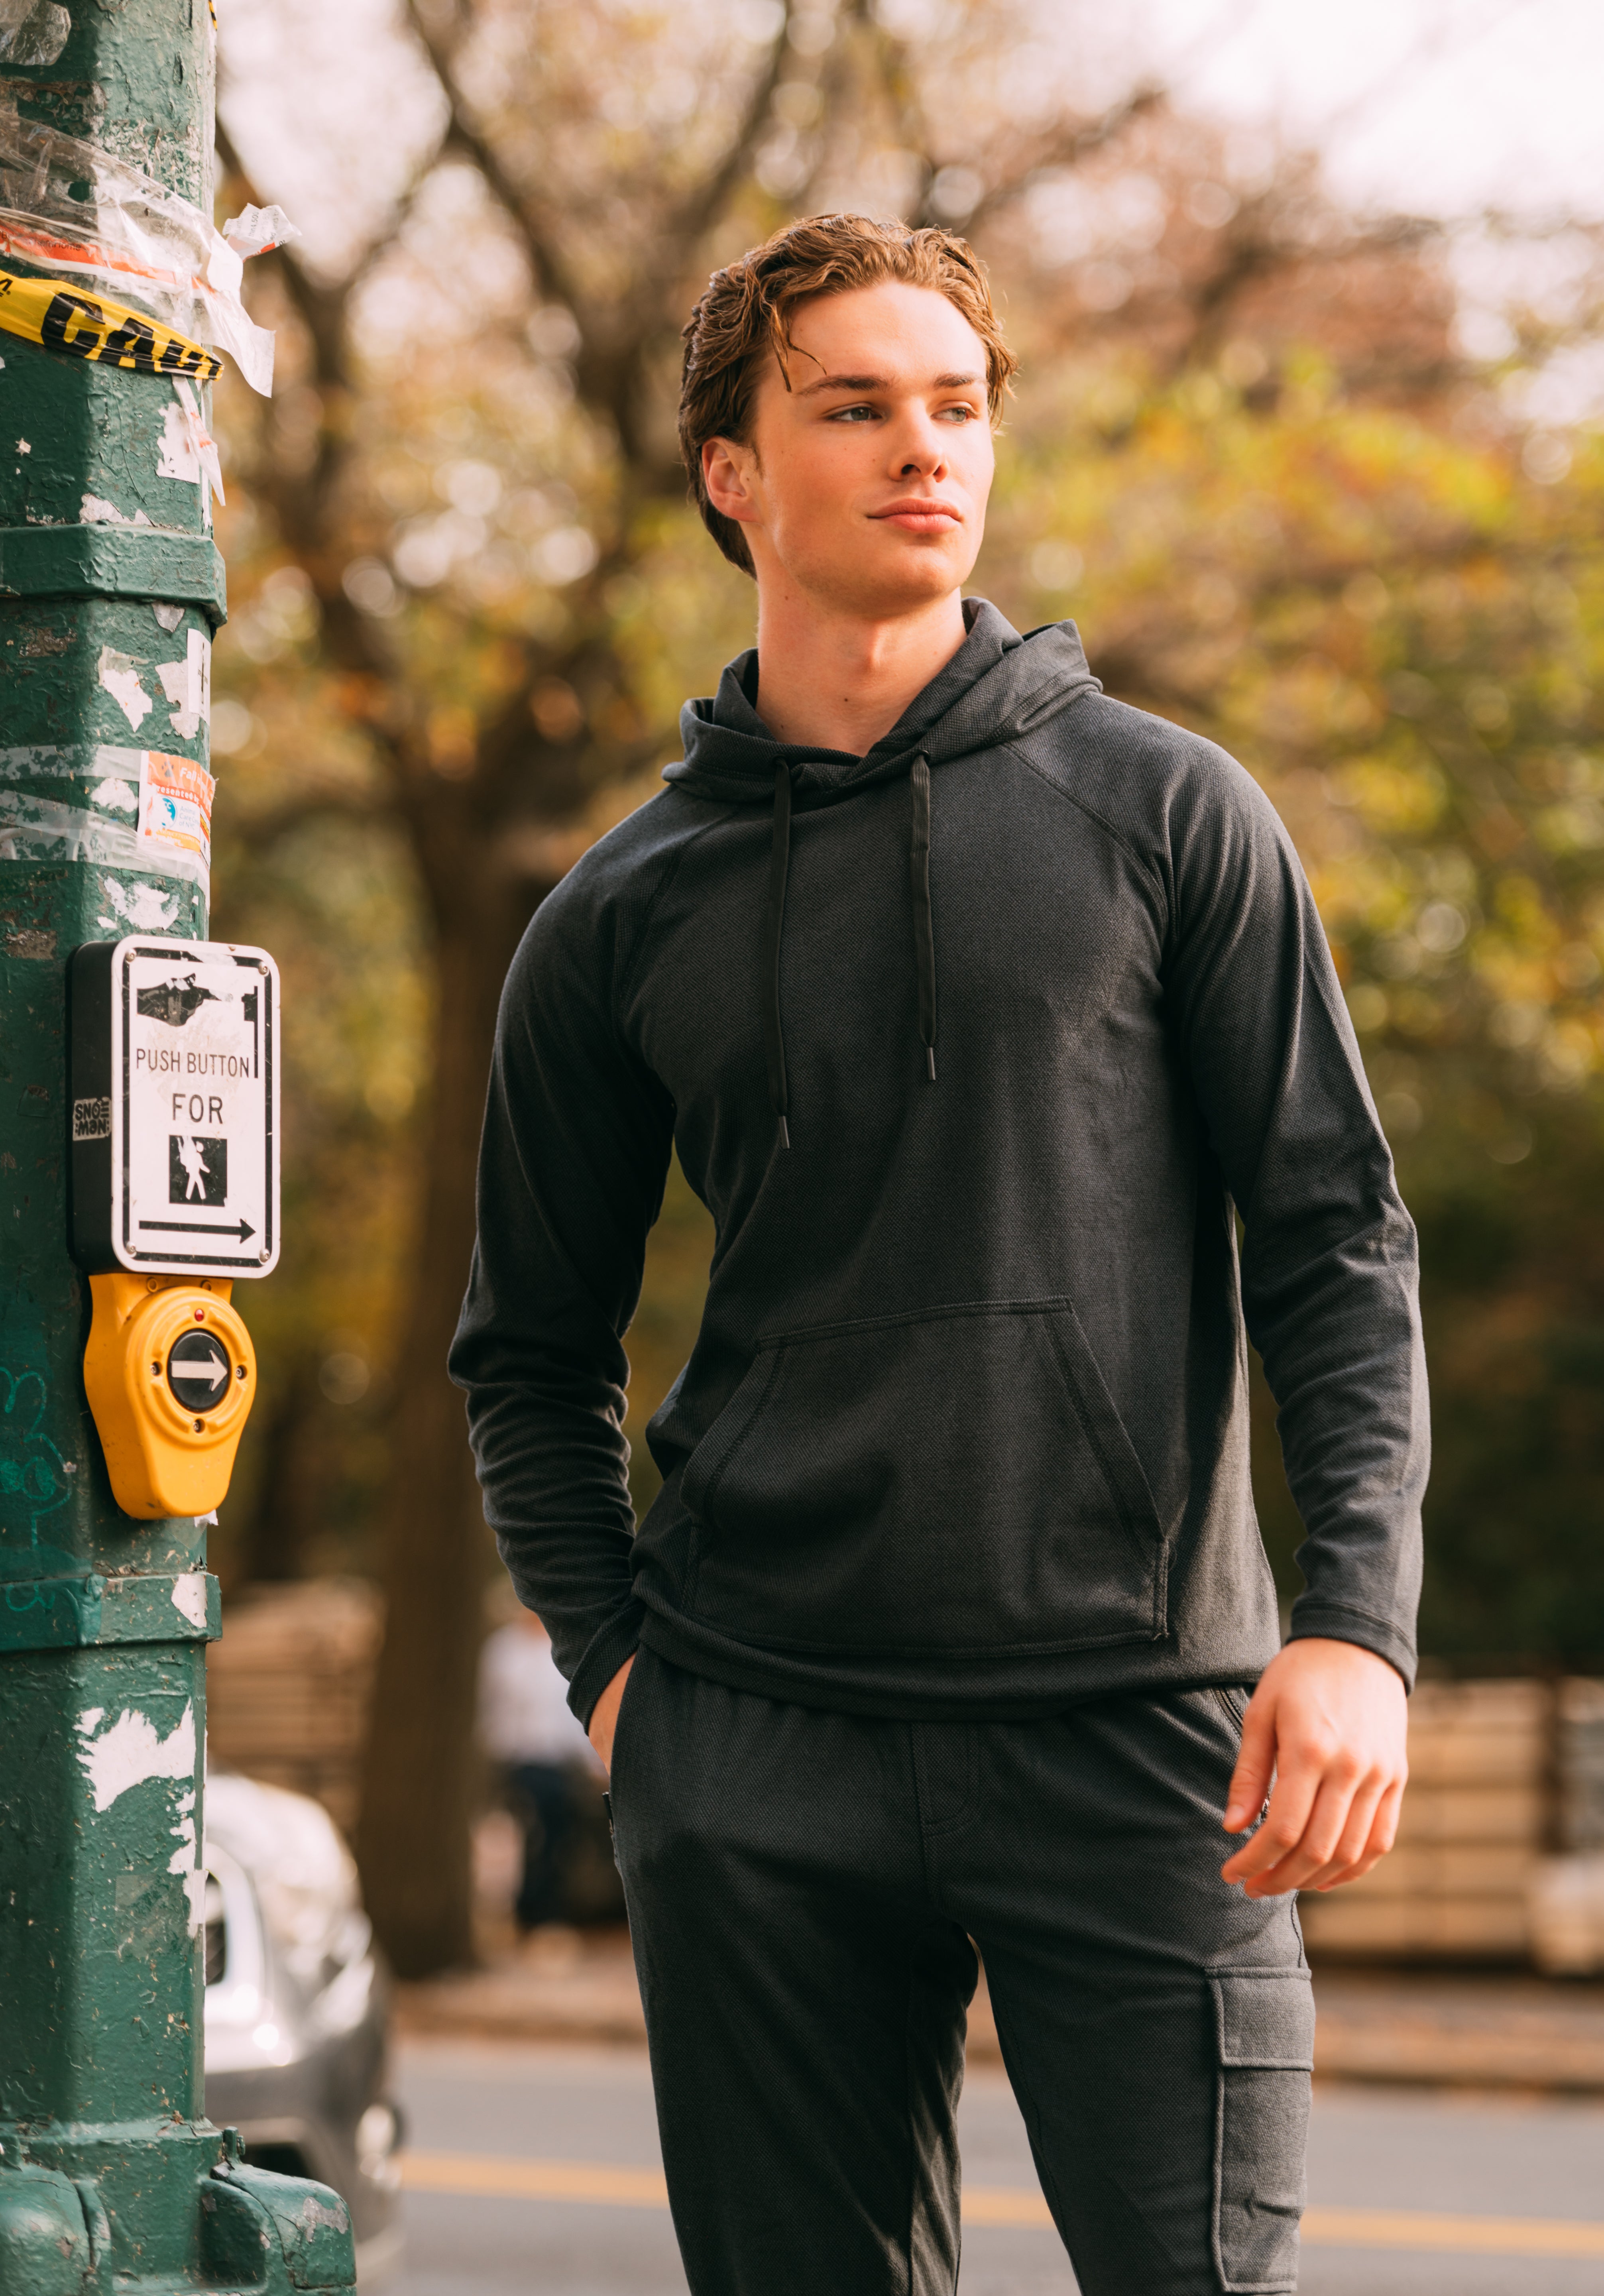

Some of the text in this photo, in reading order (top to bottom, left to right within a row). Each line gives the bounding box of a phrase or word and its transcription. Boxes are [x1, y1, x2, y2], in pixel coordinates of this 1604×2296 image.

[180, 767, 197, 782] Fall
[155, 786, 193, 800] resented
[137, 1048, 249, 1078] PUSH BUTTON
[172, 1093, 223, 1124] FOR
